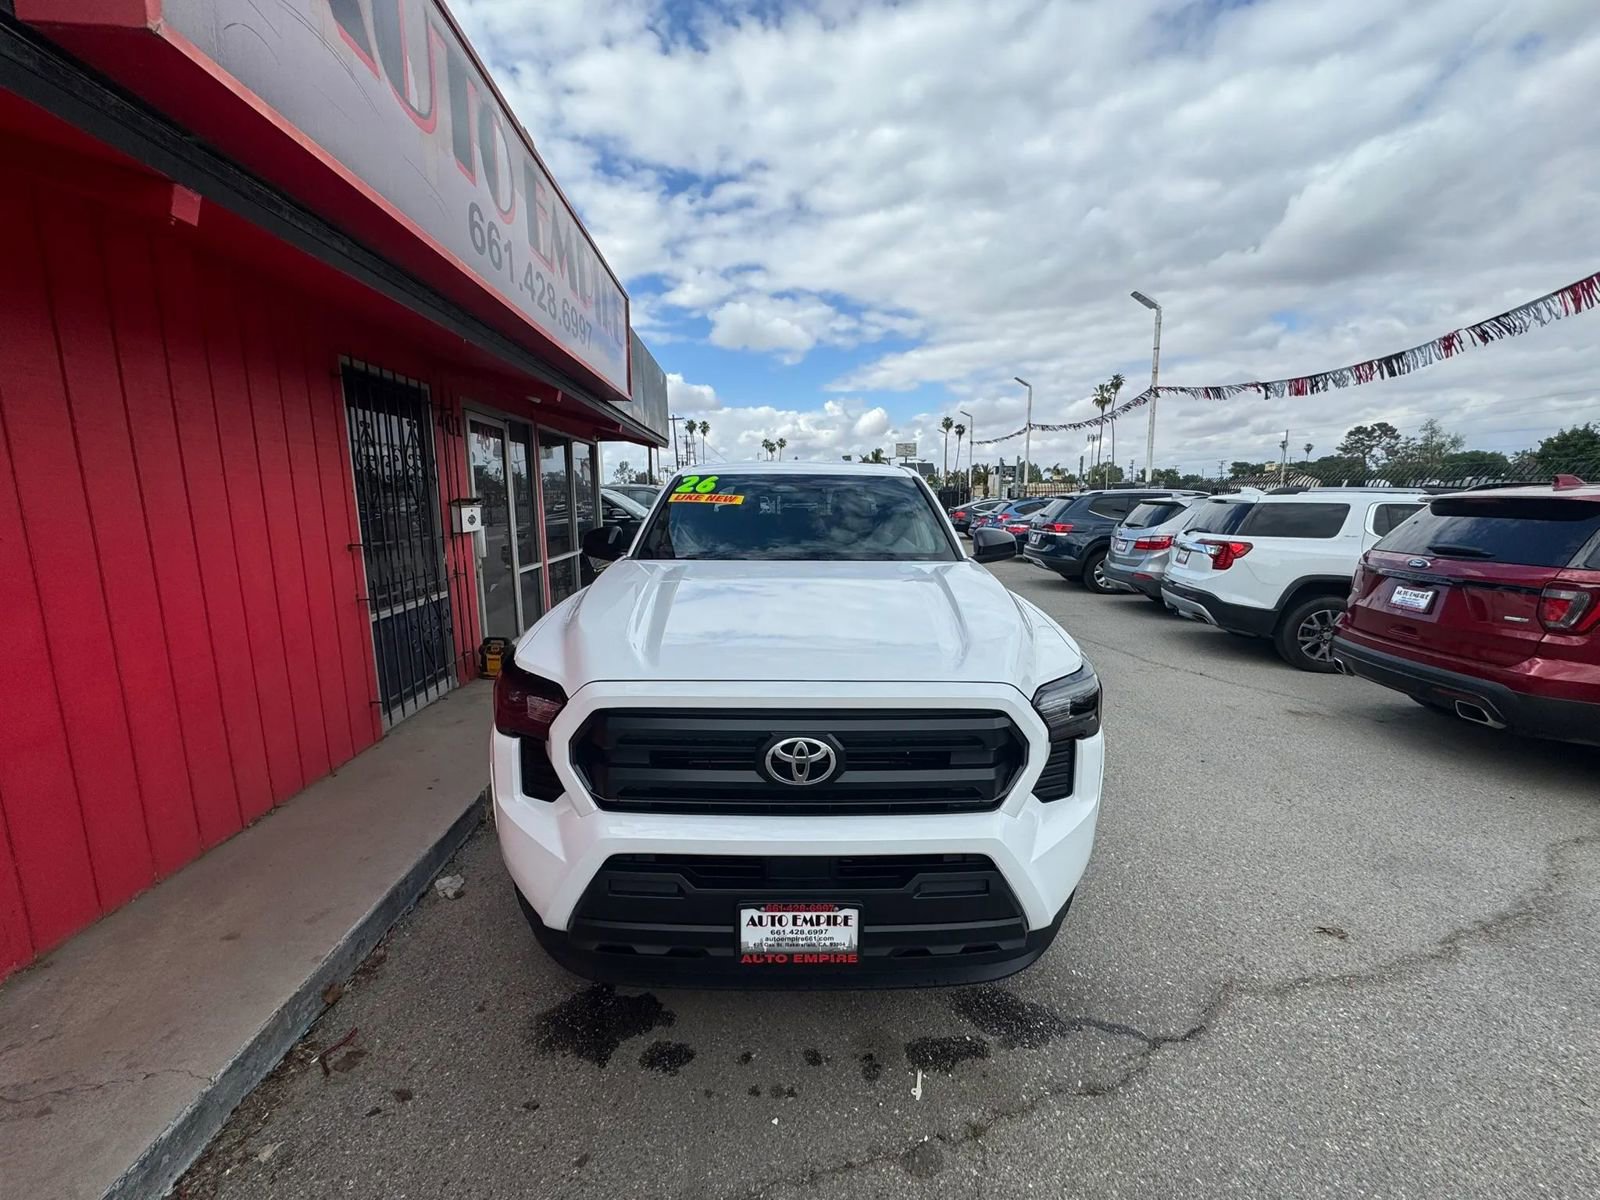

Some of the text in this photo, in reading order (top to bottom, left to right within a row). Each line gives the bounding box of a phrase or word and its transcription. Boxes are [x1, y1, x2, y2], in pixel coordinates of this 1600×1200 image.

[468, 201, 592, 350] 661.428.6997
[675, 475, 719, 493] 26
[746, 915, 853, 927] AUTO EMPIRE
[741, 954, 858, 963] AUTO EMPIRE
